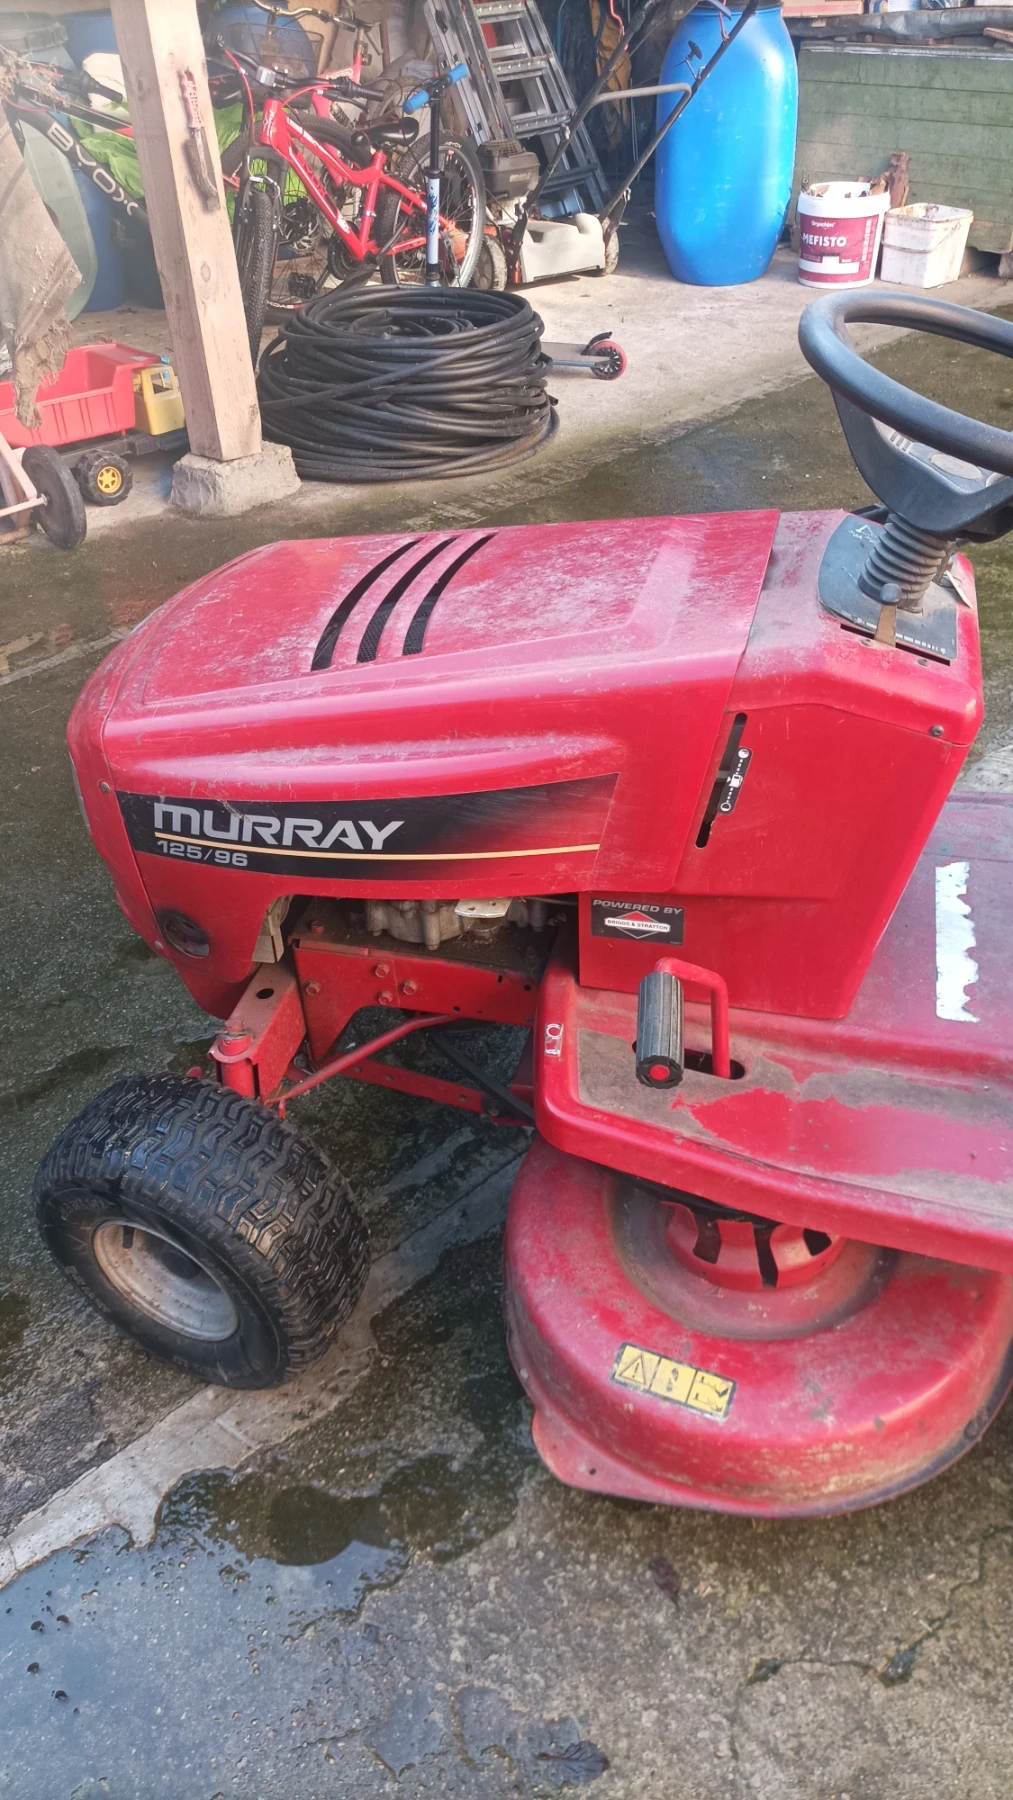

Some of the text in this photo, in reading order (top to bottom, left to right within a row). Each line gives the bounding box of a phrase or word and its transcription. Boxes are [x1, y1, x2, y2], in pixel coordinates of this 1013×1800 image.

[47, 122, 139, 216] BYOX
[803, 233, 847, 247] MEFISTO
[153, 802, 405, 850] MURRAY
[156, 839, 249, 867] 125/96
[593, 900, 683, 915] POWERED BY
[607, 919, 630, 927] BRIGGS
[637, 922, 668, 931] STRATTON
